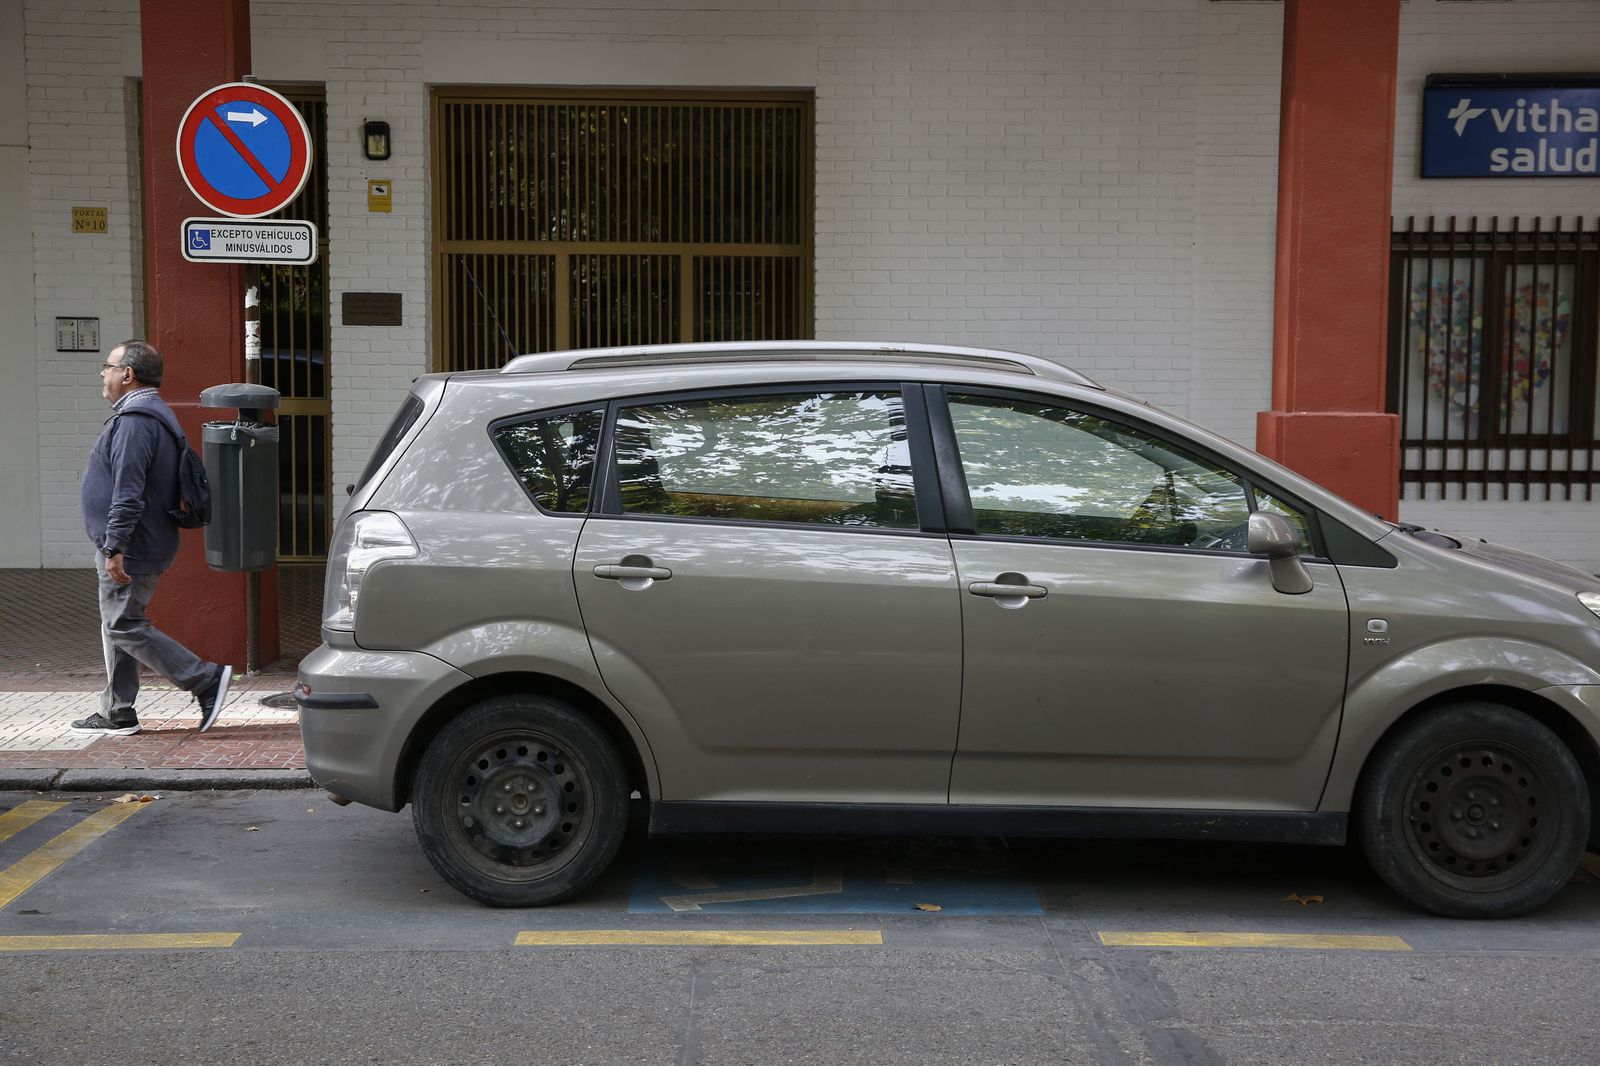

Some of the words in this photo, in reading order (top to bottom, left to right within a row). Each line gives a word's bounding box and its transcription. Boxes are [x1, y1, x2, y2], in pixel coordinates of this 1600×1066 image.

[1490, 98, 1599, 133] vitha
[1490, 138, 1598, 173] salud
[73, 209, 106, 217] PORTAL
[210, 229, 253, 239] EXCEPTO
[255, 229, 308, 241] VEHÍCULOS
[225, 242, 293, 254] MINUSVÁLIDOS
